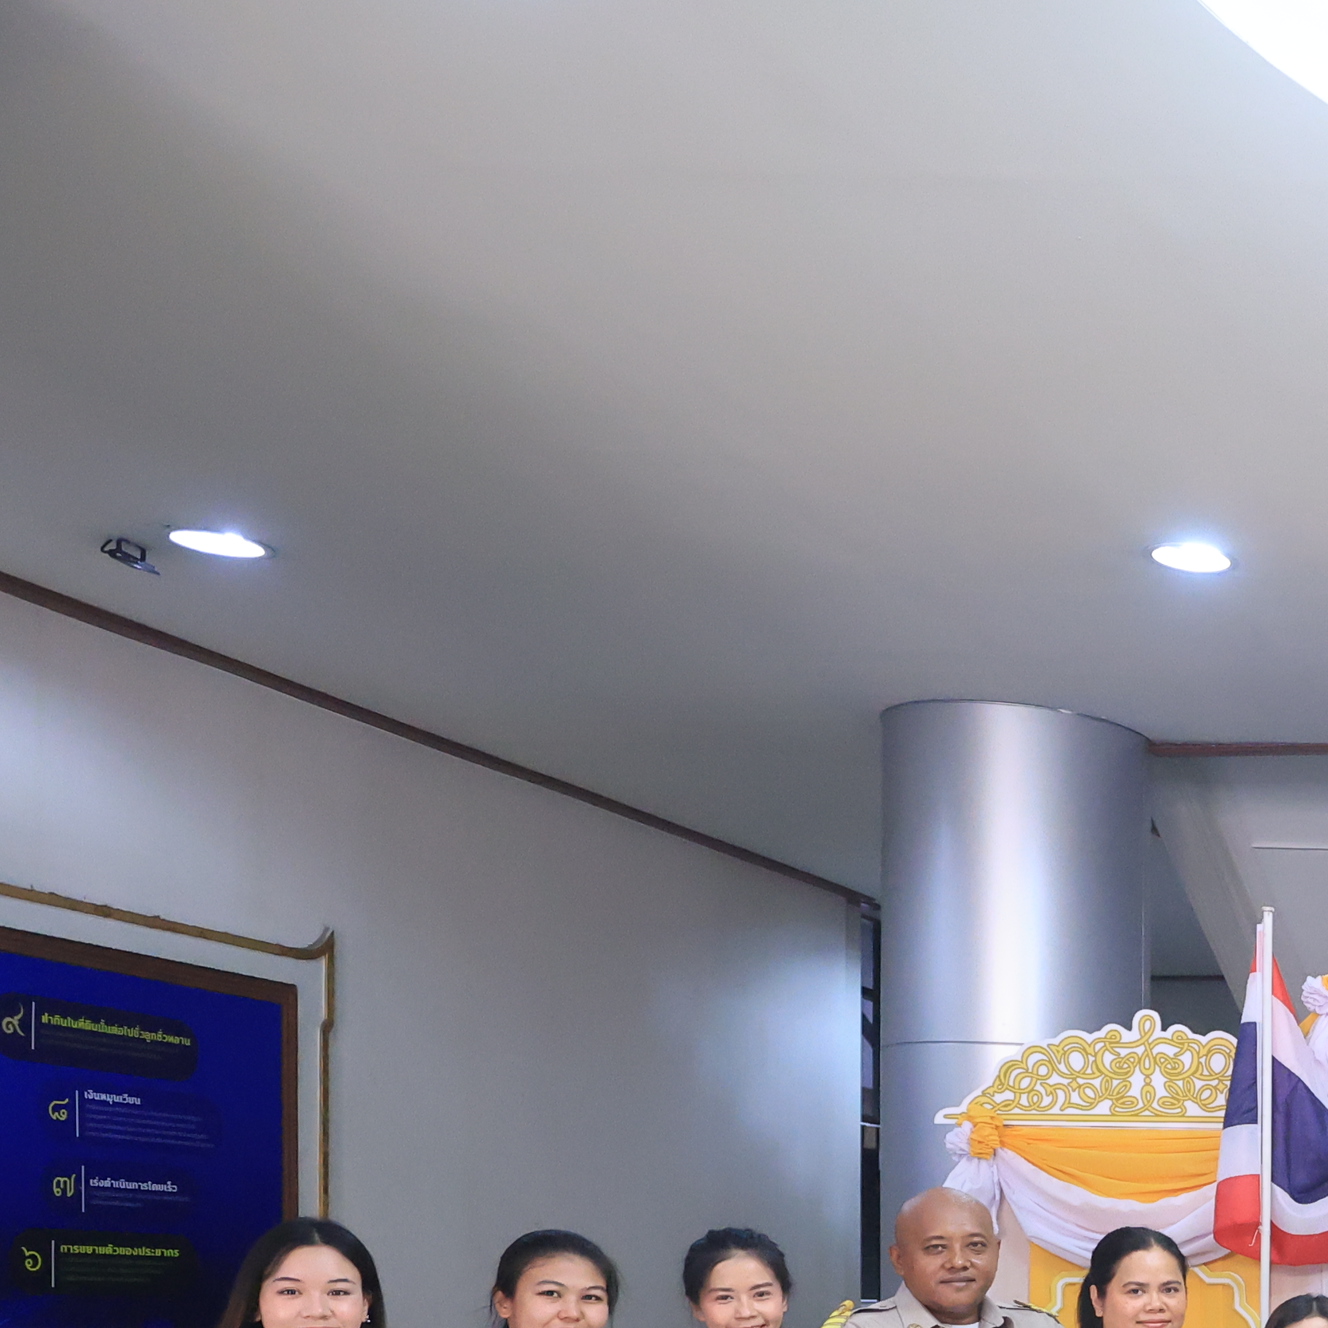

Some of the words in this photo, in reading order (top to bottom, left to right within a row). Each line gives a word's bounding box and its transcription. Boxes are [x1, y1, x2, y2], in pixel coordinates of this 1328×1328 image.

[48, 1098, 69, 1121] ๘
[52, 1173, 76, 1198] ๗
[21, 1246, 42, 1272] ๖
